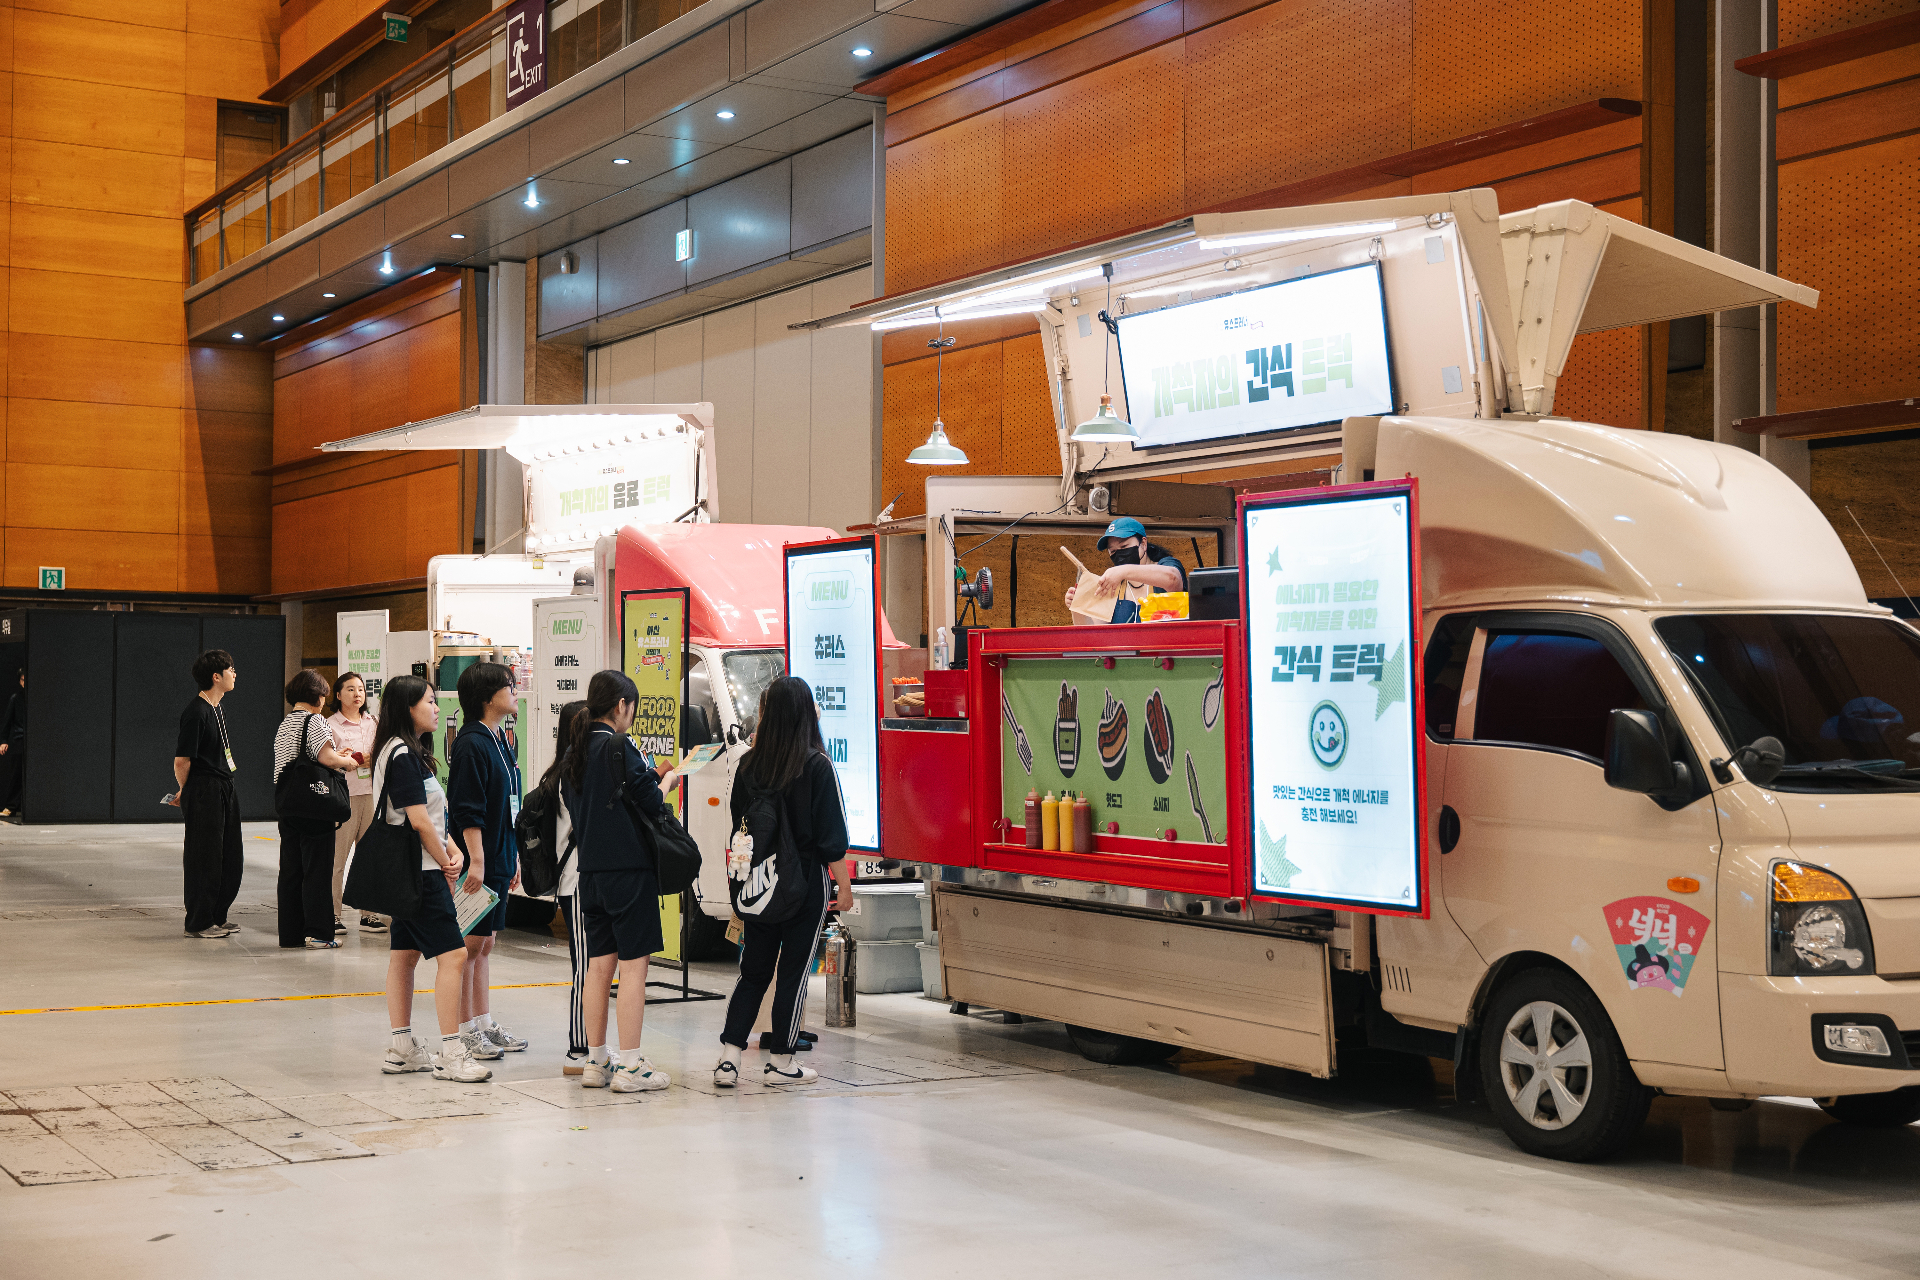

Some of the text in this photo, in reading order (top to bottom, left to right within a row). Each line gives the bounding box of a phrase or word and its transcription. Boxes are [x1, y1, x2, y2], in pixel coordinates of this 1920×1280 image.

[536, 13, 543, 54] 1
[525, 63, 543, 88] EXIT
[1151, 333, 1353, 418] 개척자의 간식 트럭
[559, 475, 671, 516] 개척자의 음료 트럭
[1108, 524, 1115, 533] S
[810, 579, 849, 602] MENU
[1276, 580, 1379, 605] 에너지가 필요한
[552, 618, 583, 635] MENU
[1276, 608, 1378, 632] 개척자들을 위한
[814, 633, 846, 660] 츄러스
[554, 654, 580, 667] 아메리카노
[1271, 643, 1386, 683] 간식 트럭
[366, 679, 383, 698] 트럭
[814, 685, 847, 711] 핫도그
[639, 696, 676, 717] FOOD
[632, 716, 675, 736] TRUCK
[639, 737, 675, 756] ZONE
[827, 738, 848, 763] 시지
[1106, 792, 1123, 809] 핫도그
[1152, 796, 1170, 812] 소시지
[1272, 785, 1389, 805] 맛있는 간식으로 개척 에너지를
[1301, 806, 1358, 824] 충전 해보세요!
[741, 853, 779, 901] NIKE
